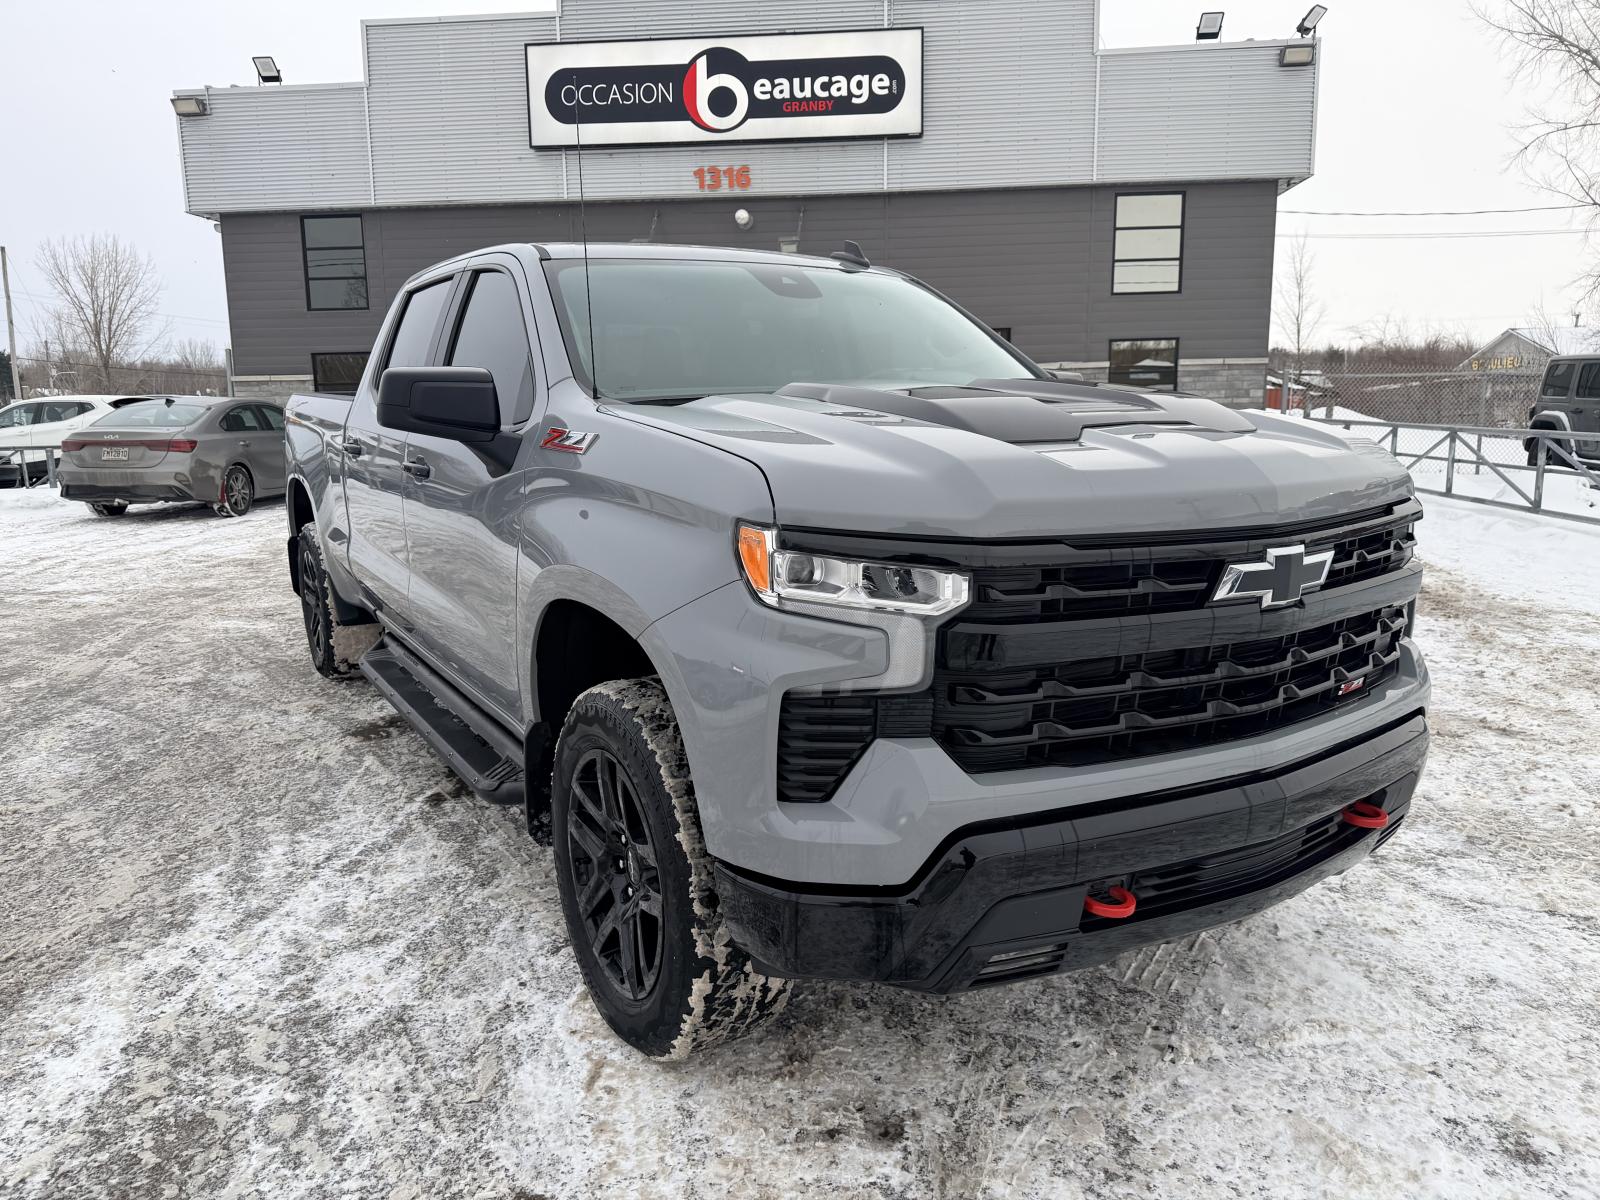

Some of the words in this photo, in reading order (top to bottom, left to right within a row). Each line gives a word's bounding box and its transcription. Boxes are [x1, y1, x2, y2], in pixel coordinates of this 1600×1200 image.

[561, 82, 673, 105] OCCASION
[782, 99, 834, 113] GRANBY
[693, 165, 752, 190] 1316
[540, 427, 599, 454] Z71
